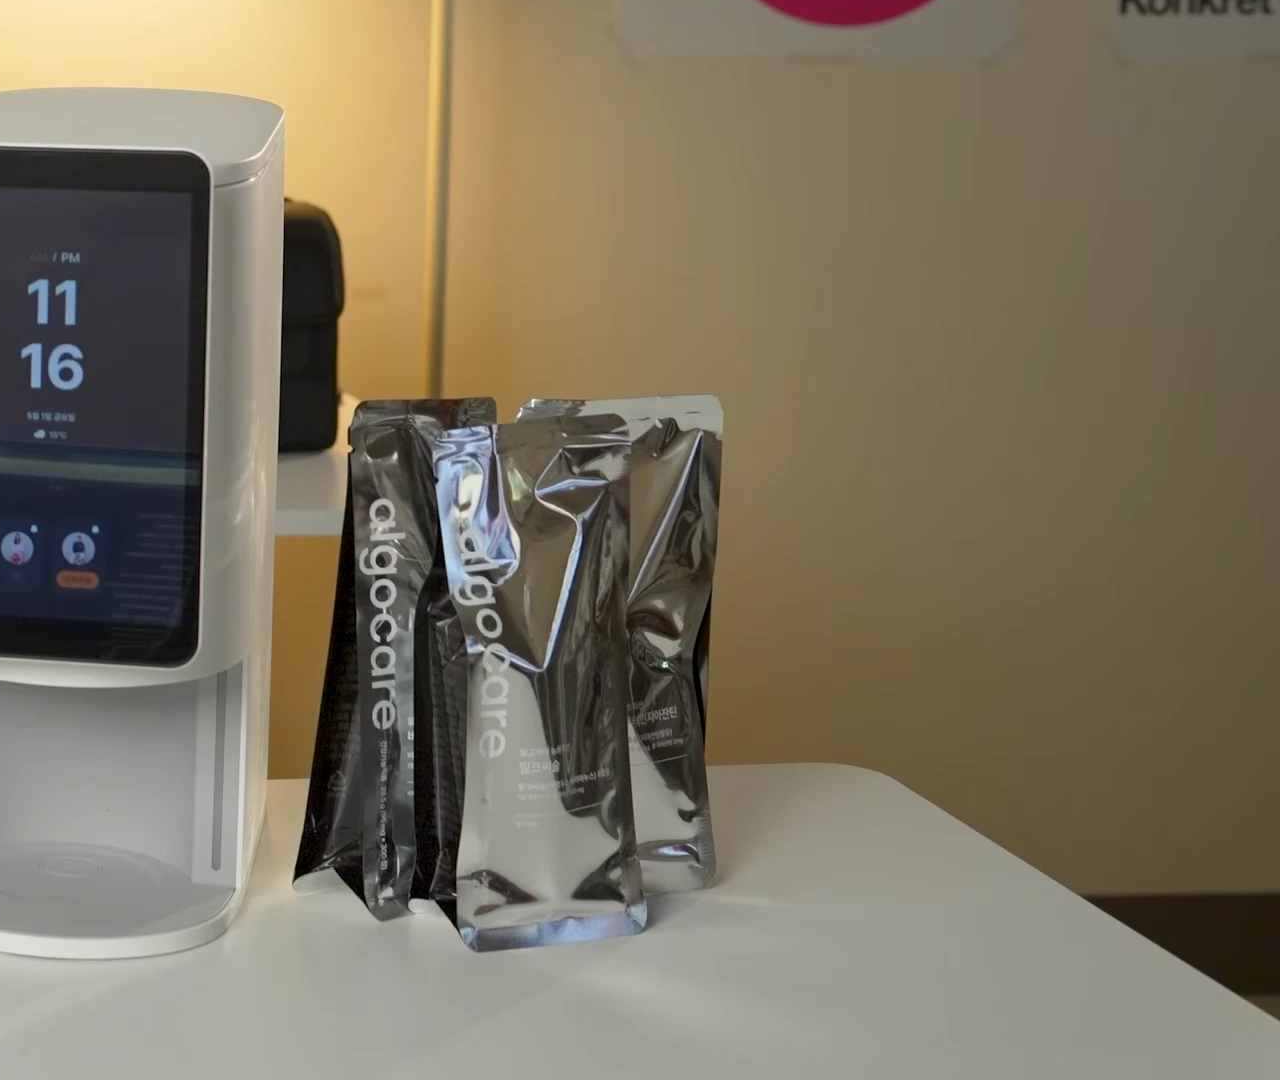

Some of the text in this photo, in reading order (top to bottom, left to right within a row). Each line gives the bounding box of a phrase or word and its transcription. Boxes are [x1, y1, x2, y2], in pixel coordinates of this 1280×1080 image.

[60, 251, 81, 264] PM
[27, 278, 77, 326] 11
[19, 342, 85, 391] 16
